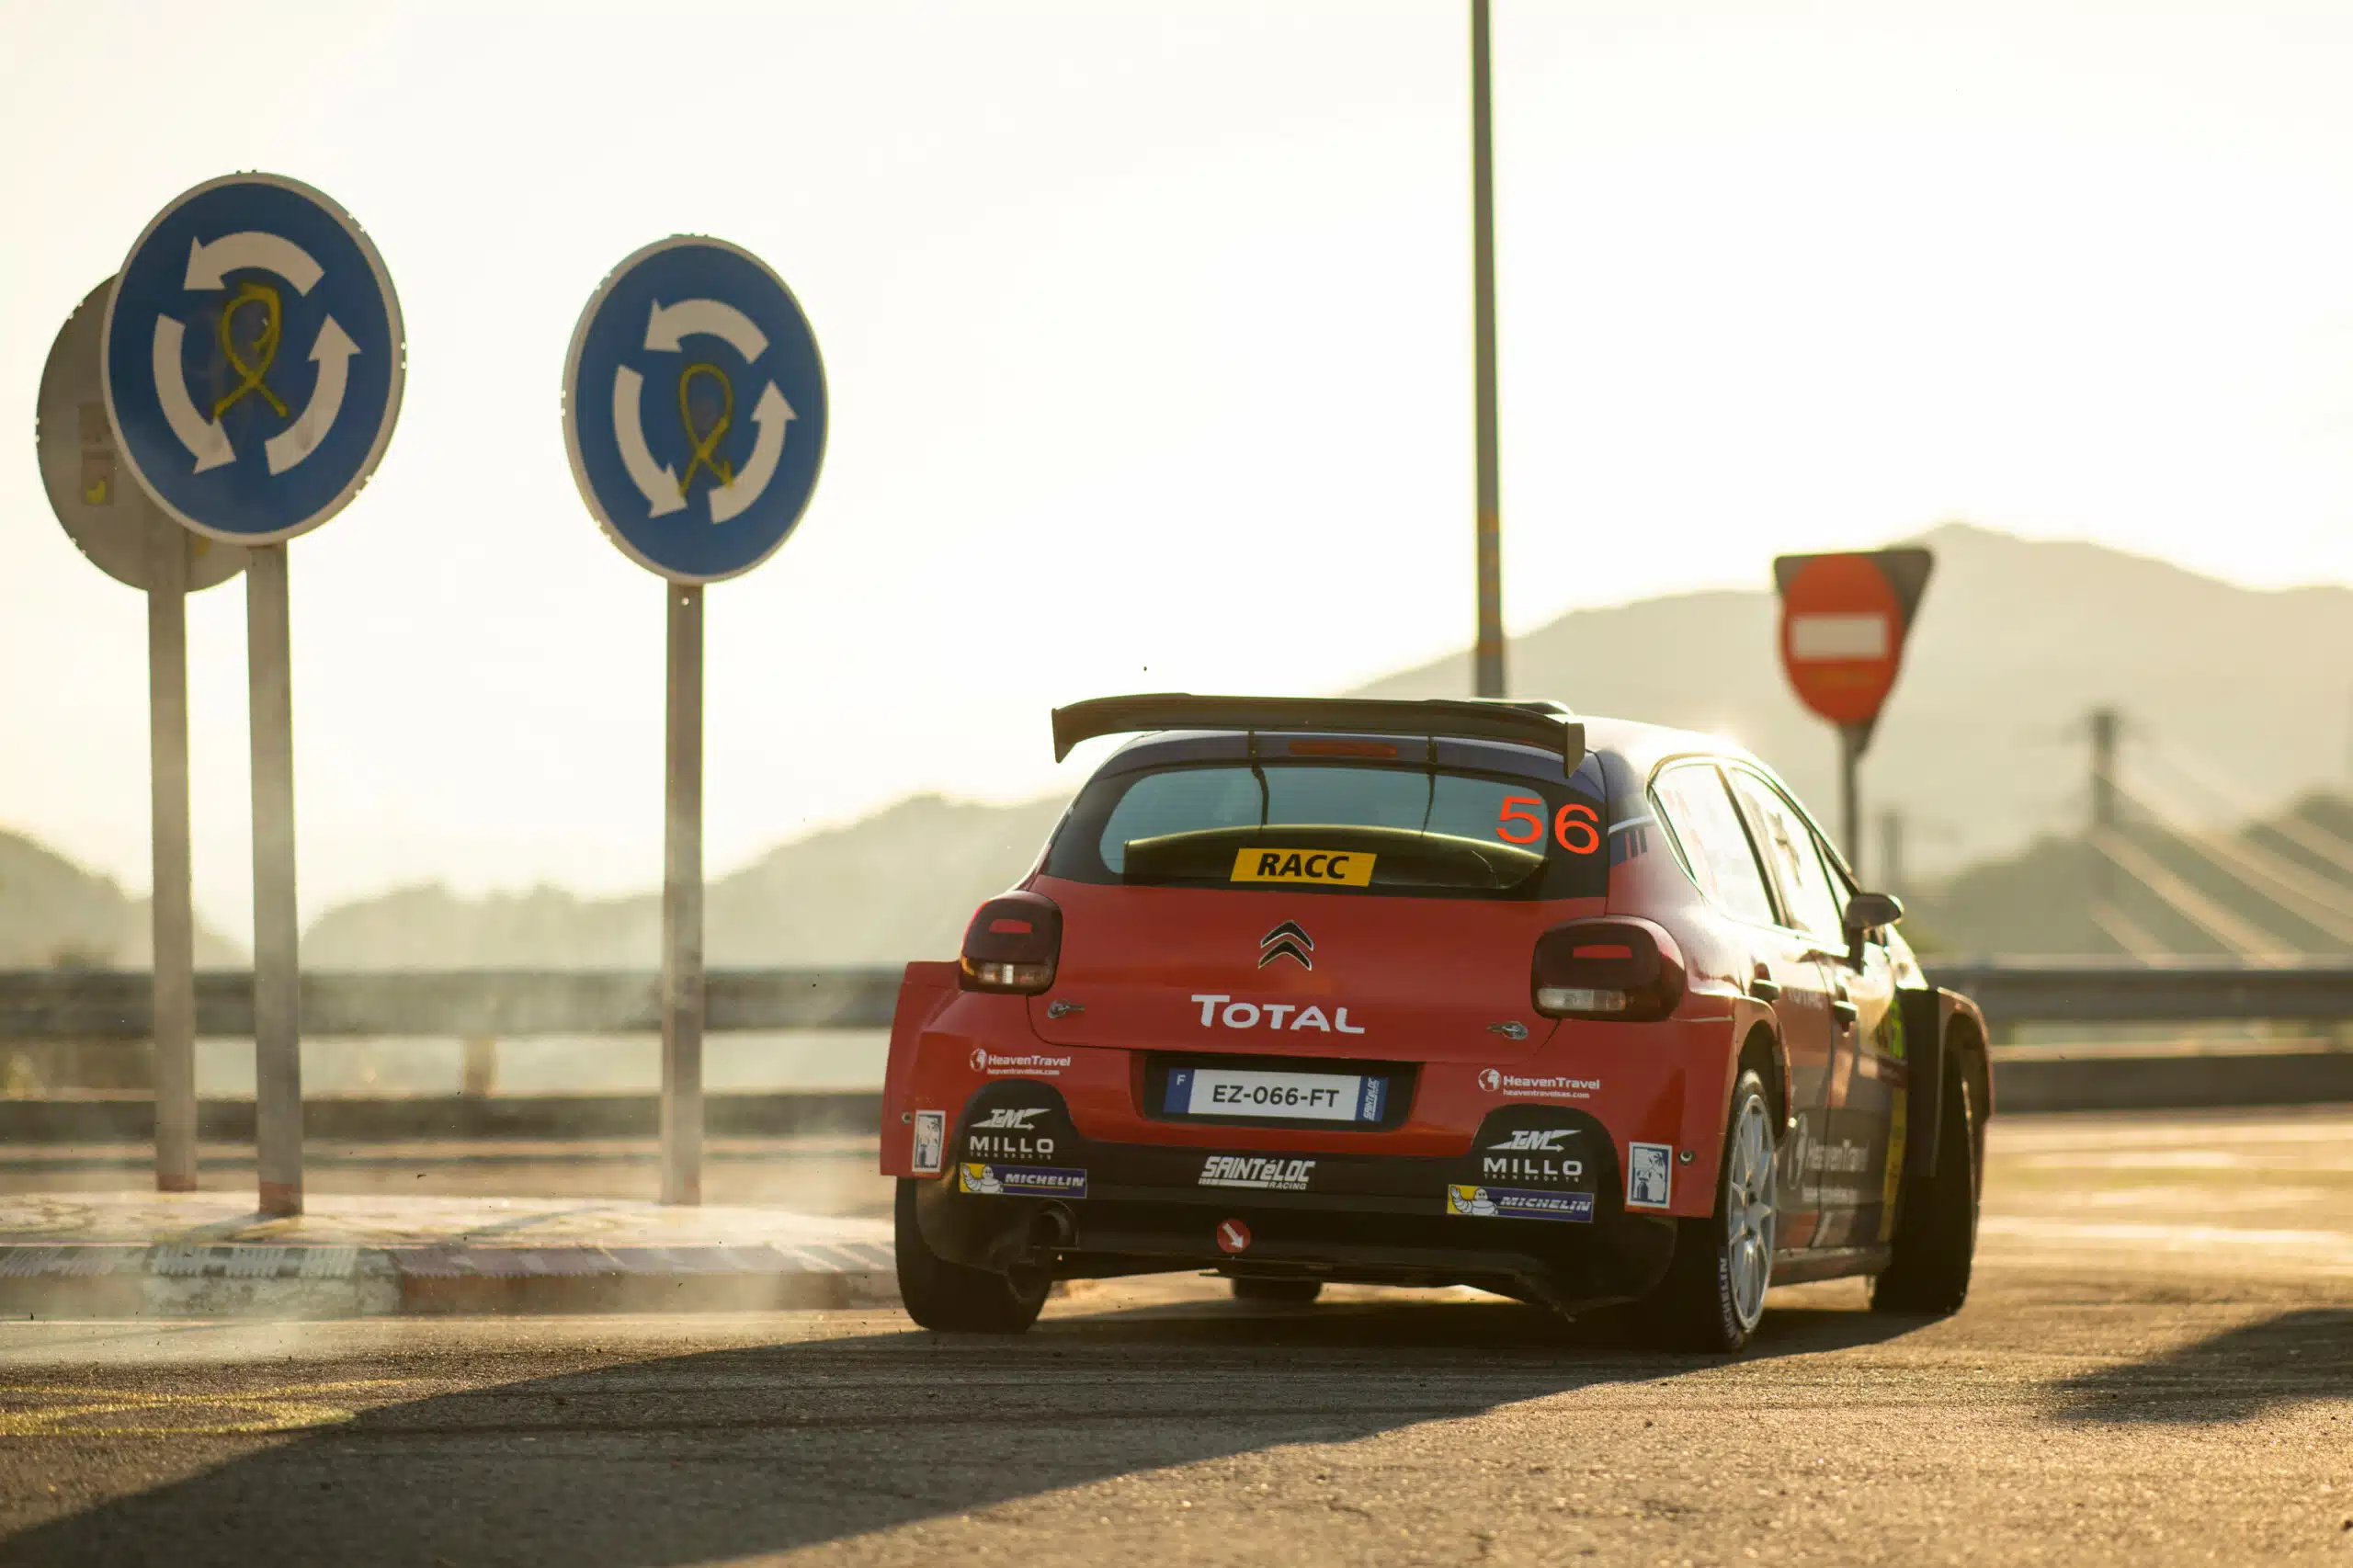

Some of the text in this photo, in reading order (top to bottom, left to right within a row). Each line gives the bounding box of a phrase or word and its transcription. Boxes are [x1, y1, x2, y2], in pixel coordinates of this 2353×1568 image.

[1495, 795, 1600, 855] 56
[1256, 852, 1350, 880] RACC
[1191, 994, 1365, 1034] TOTAL
[1176, 1074, 1186, 1085] F
[1503, 1075, 1600, 1090] HeavenTravel
[1212, 1084, 1340, 1108] EZ-066-FT
[970, 1135, 1054, 1153] MILLO
[1483, 1157, 1583, 1176] MILLO
[1005, 1173, 1085, 1187] MICHELIN
[1268, 1181, 1307, 1190] RACING
[1499, 1196, 1591, 1211] MICHELIN
